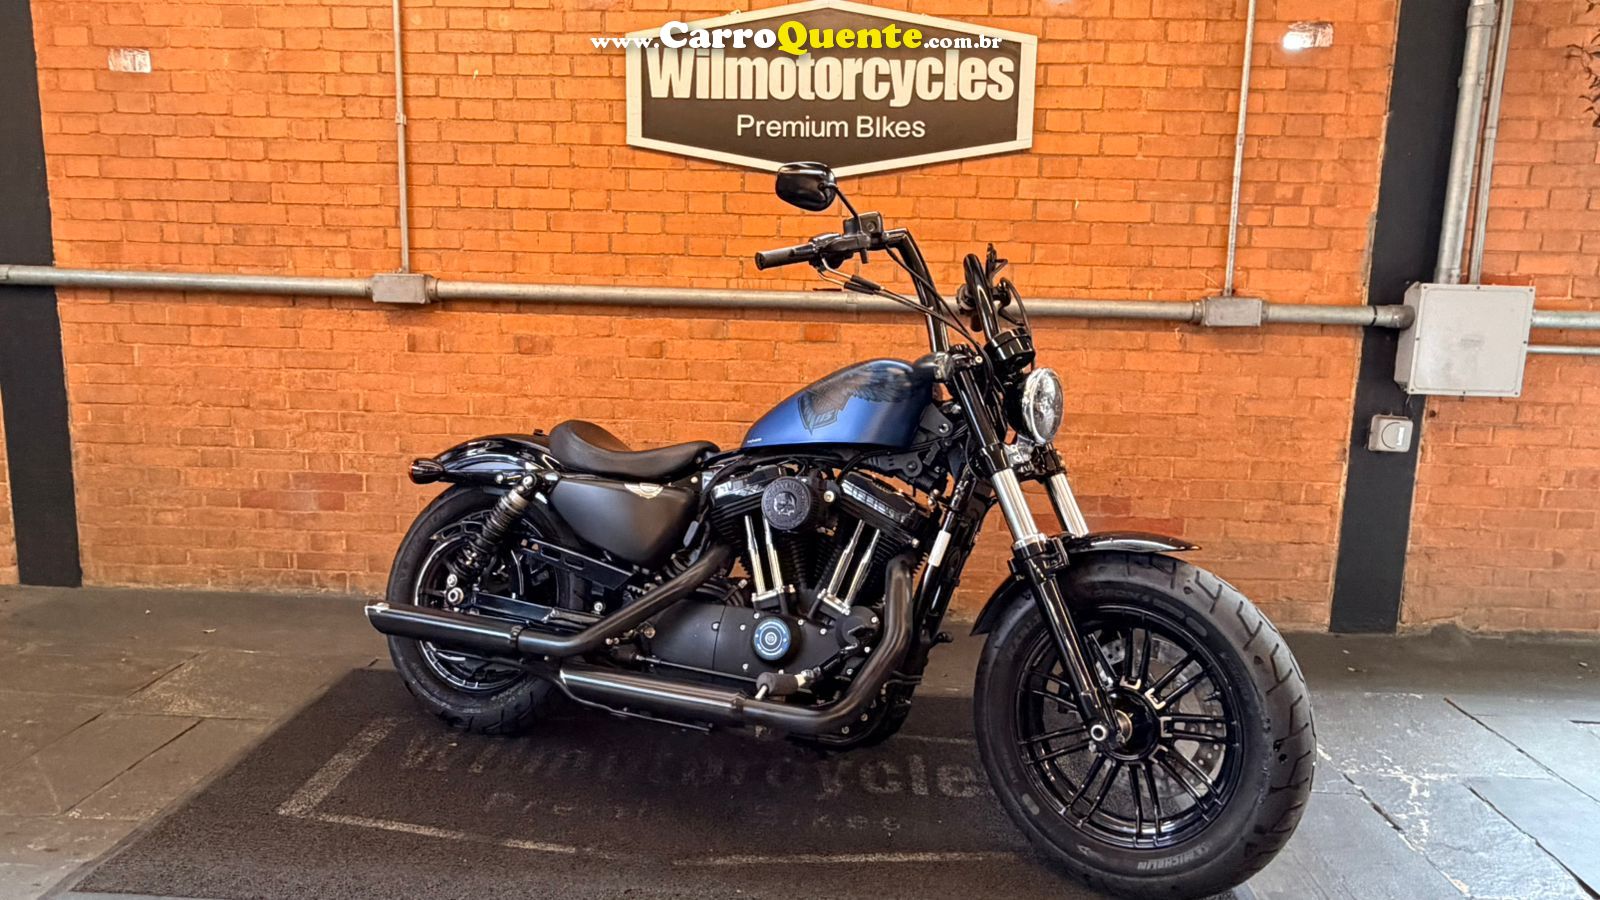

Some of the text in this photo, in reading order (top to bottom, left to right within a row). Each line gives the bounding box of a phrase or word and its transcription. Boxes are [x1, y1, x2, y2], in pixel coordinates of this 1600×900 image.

[646, 47, 1015, 107] Wilmotorcycles
[736, 114, 849, 138] Premium
[1137, 848, 1194, 870] MICHELIN
